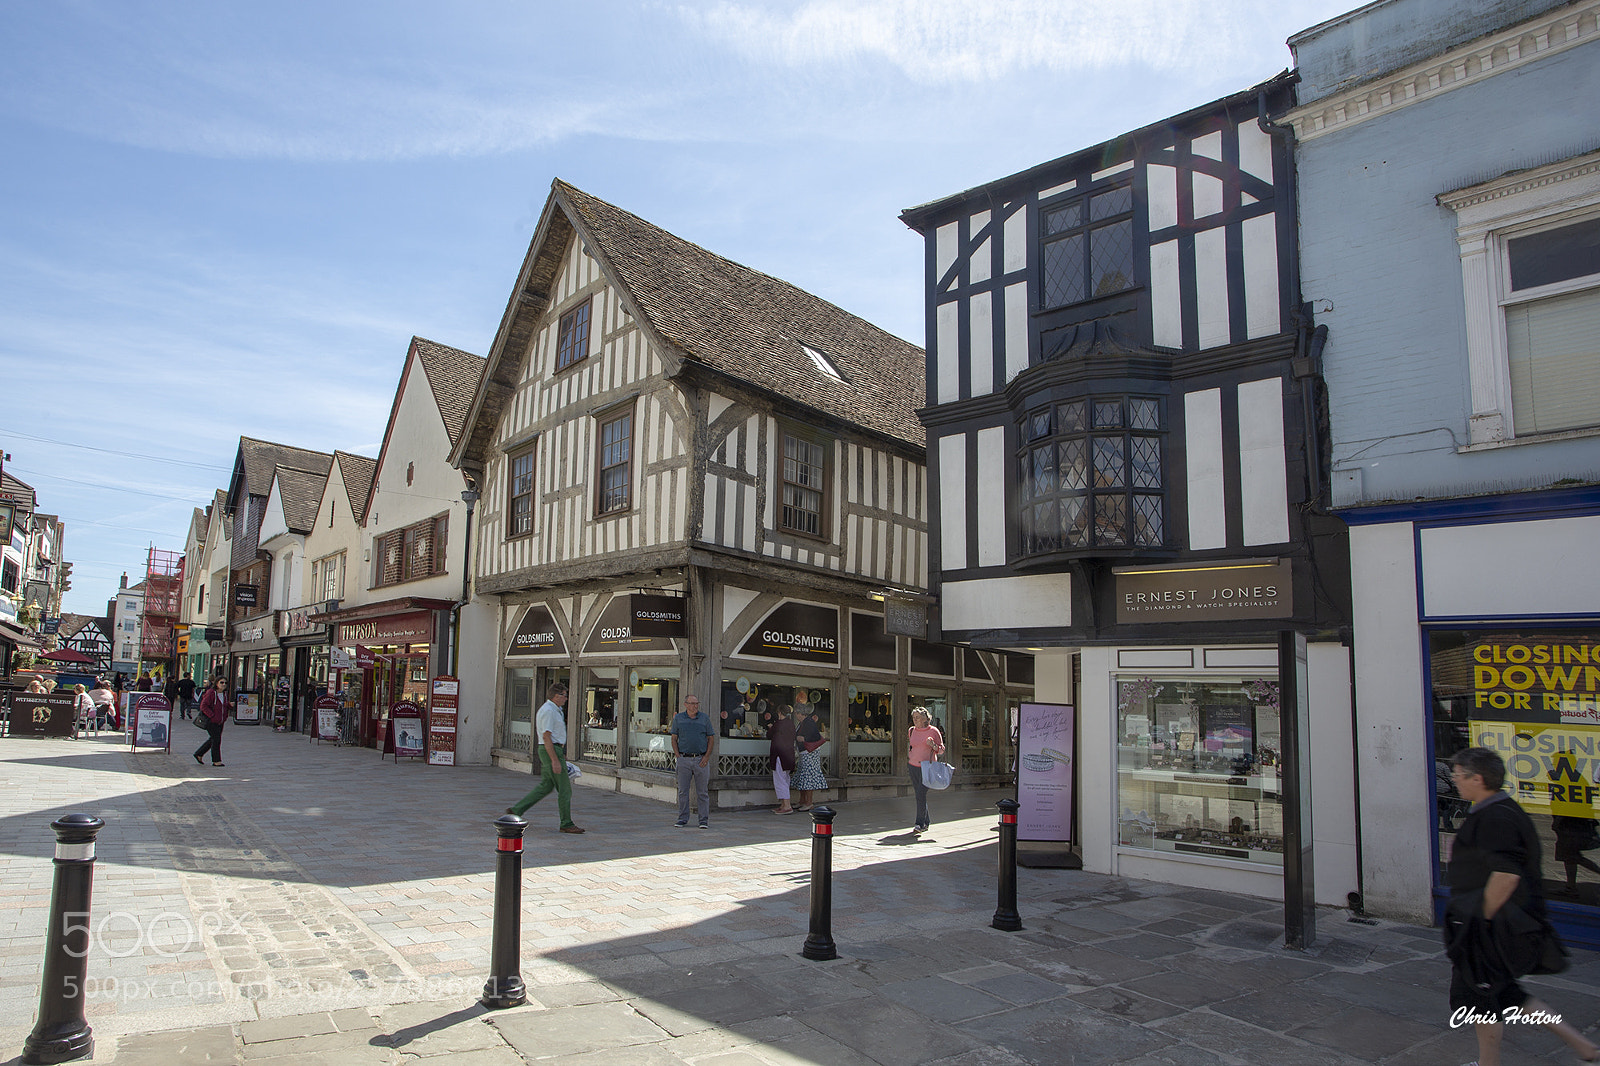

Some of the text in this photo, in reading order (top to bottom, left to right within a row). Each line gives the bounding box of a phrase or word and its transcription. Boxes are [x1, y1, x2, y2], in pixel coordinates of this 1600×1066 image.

[1125, 585, 1278, 604] ERNEST JONES
[1228, 600, 1278, 608] SPECIALIST
[636, 610, 682, 620] GOLDSMITHS
[342, 621, 378, 641] TIMPSON
[517, 632, 554, 644] GOLDSMITHS
[762, 630, 835, 649] GOLDSMITHS
[1475, 691, 1532, 710] FOR
[1507, 754, 1600, 783] OW
